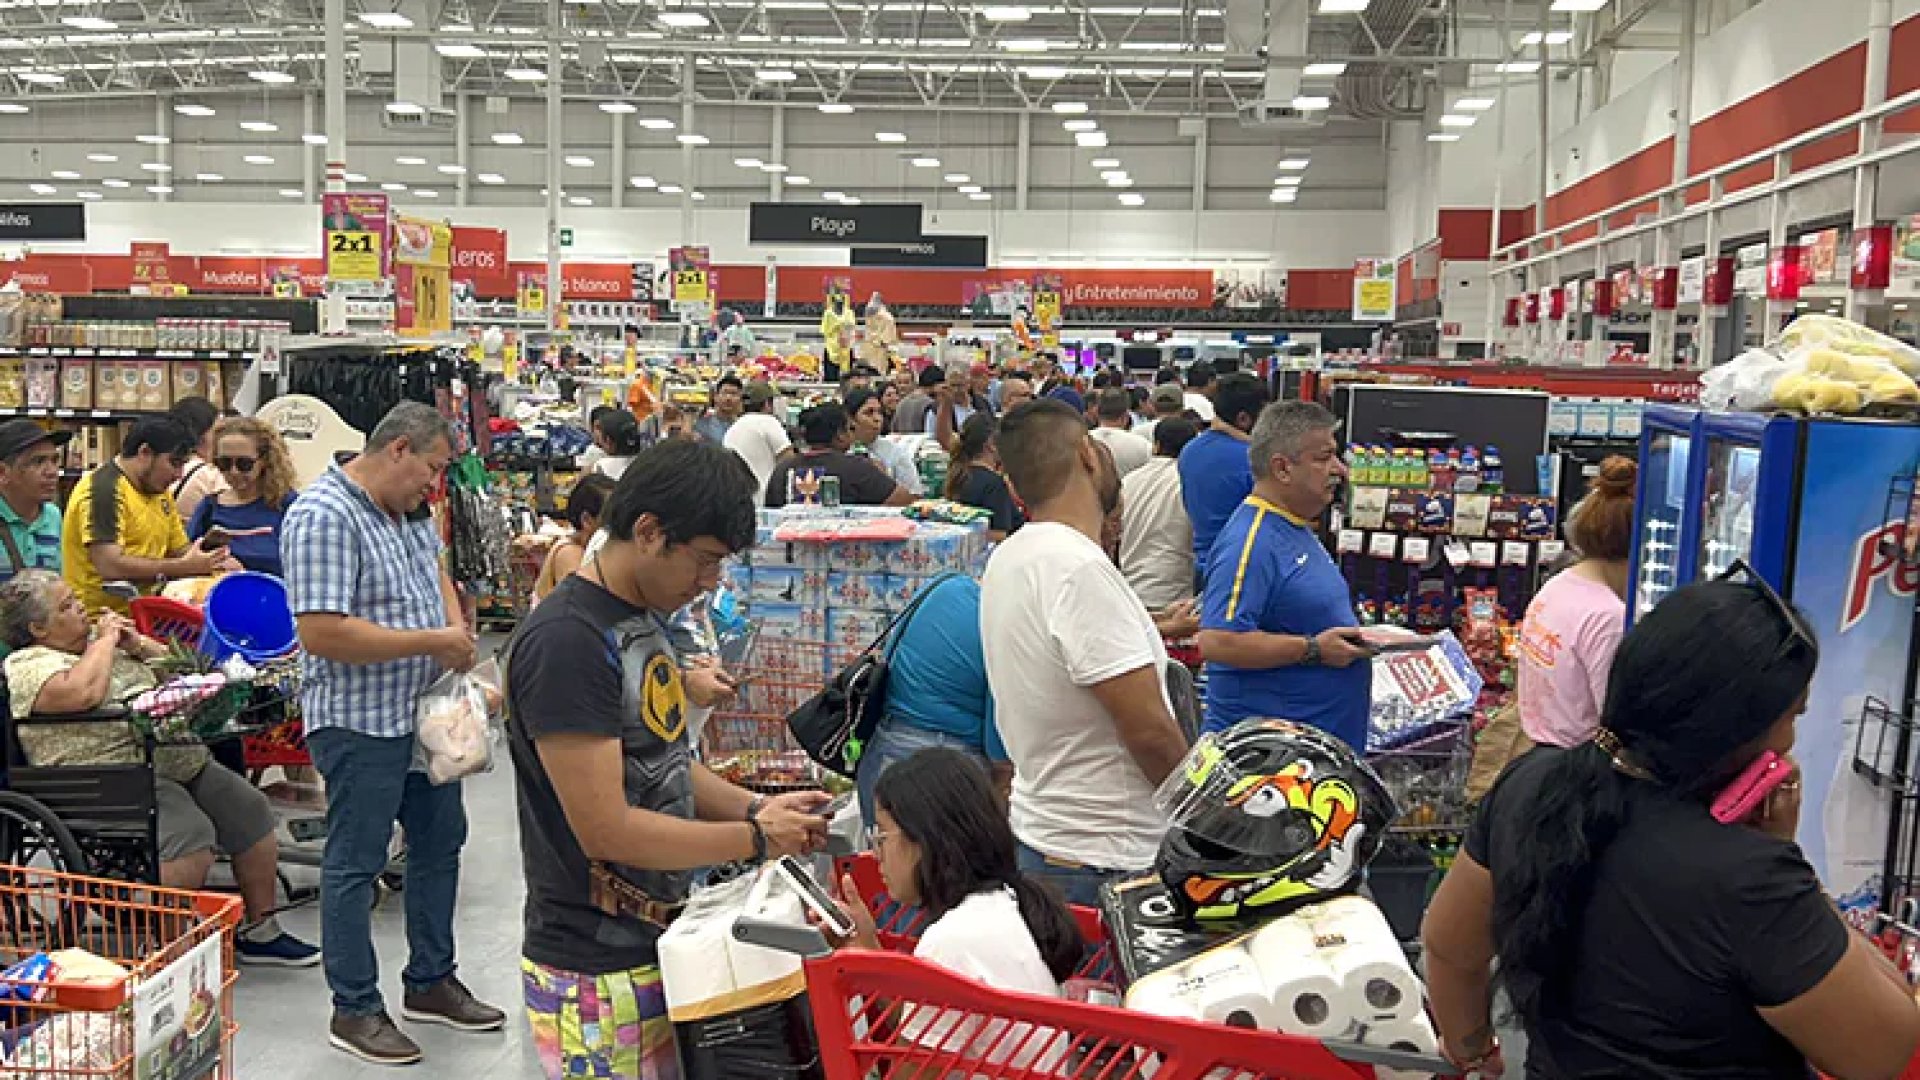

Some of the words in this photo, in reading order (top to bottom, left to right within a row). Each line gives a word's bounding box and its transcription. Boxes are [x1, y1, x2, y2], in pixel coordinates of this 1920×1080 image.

[811, 217, 855, 236] Playa
[333, 235, 374, 253] 2x1
[203, 271, 258, 286] Muebles
[573, 275, 621, 292] blanca
[678, 272, 702, 285] 2x1
[1064, 288, 1074, 304] y
[1075, 284, 1199, 300] Entretenimiento
